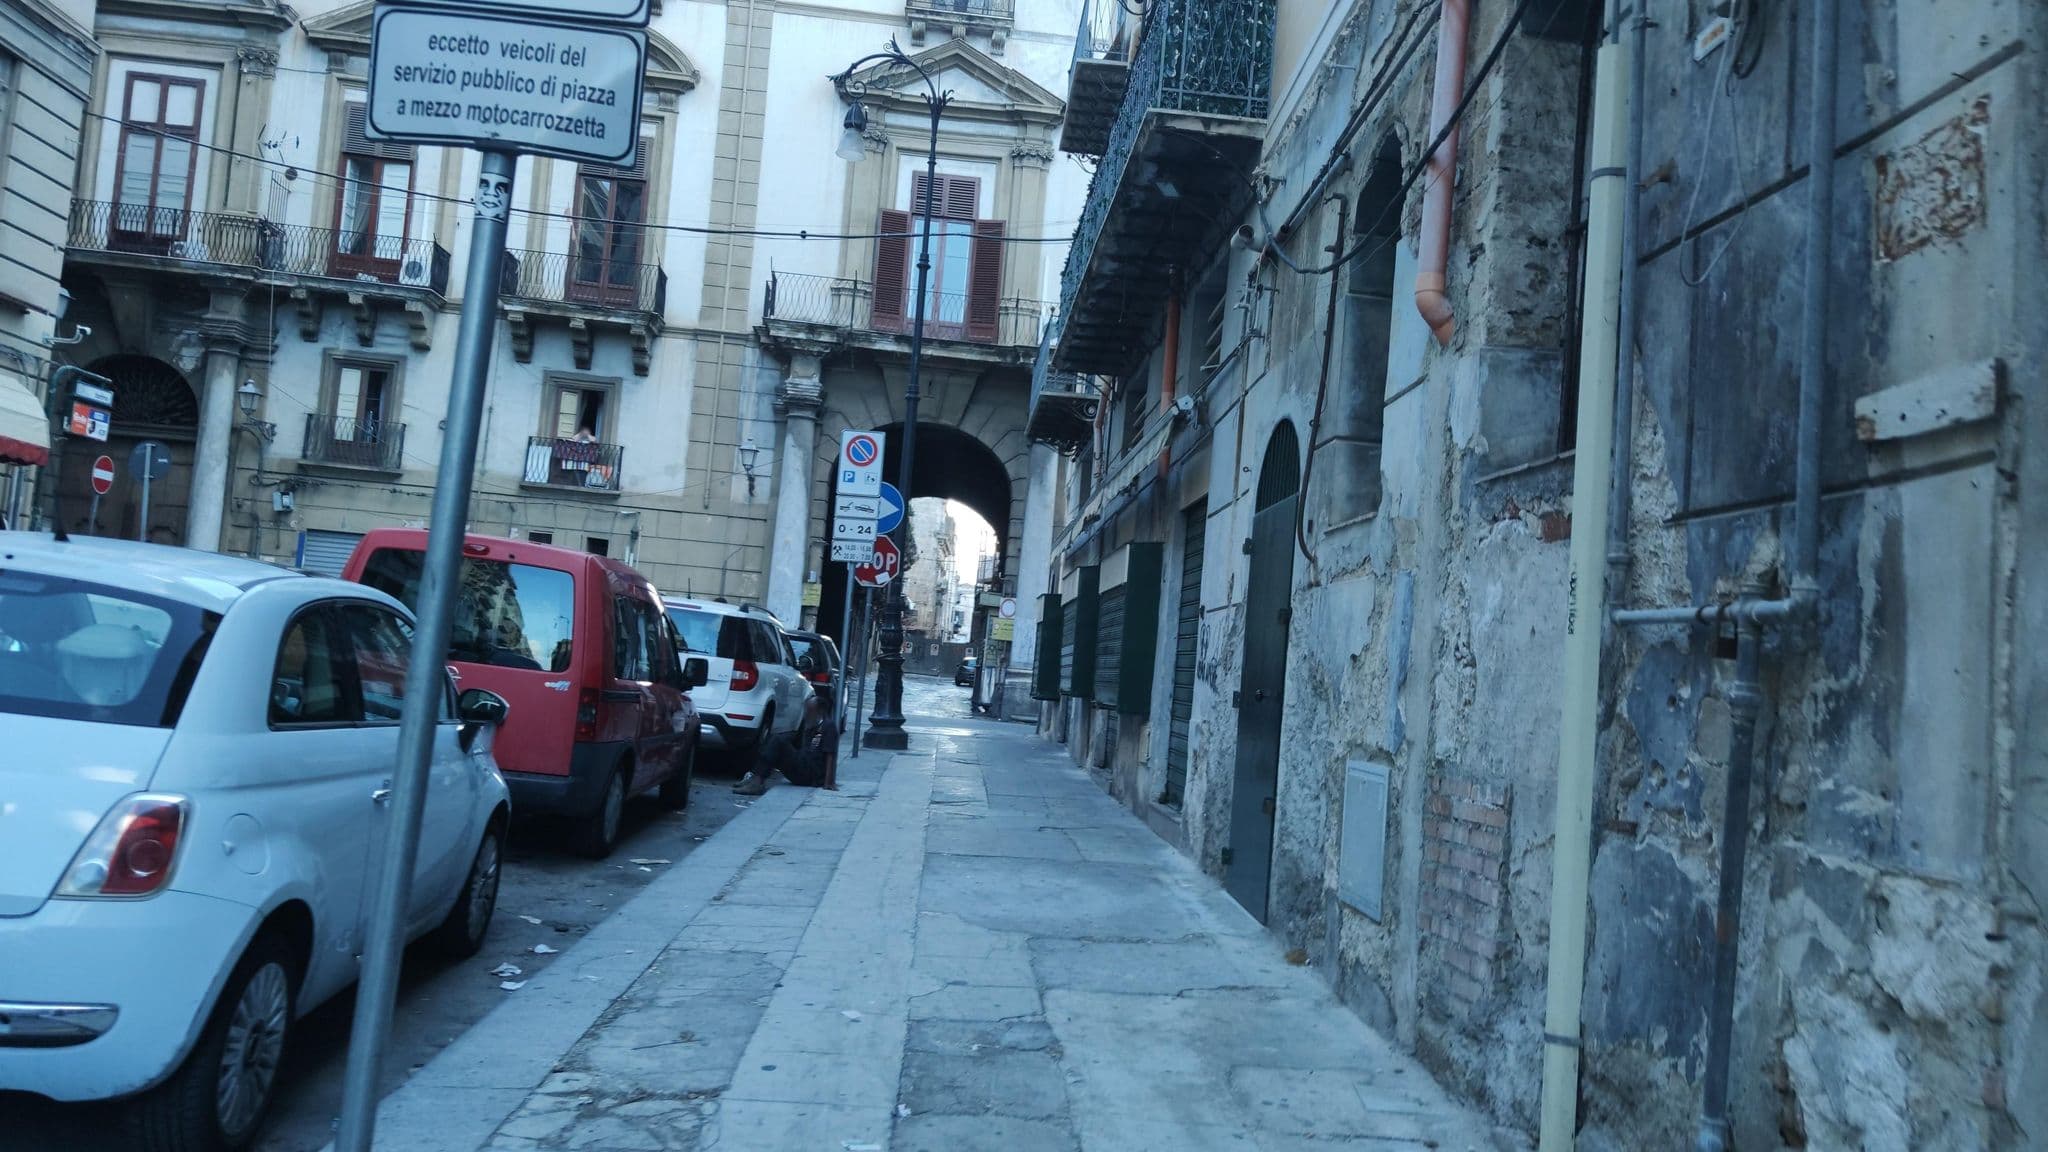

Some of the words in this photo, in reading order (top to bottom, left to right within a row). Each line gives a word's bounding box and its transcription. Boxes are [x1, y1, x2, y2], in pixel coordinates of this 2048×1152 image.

[428, 33, 489, 56] eccetto
[500, 39, 556, 64] veicoli
[560, 46, 587, 68] del
[394, 63, 456, 85] servizio
[461, 68, 535, 94] pubblico
[541, 76, 556, 97] di
[560, 78, 616, 106] piazza
[397, 99, 406, 116] a
[411, 99, 462, 119] mezzo
[466, 104, 605, 140] motocarrozzetta
[857, 525, 872, 534] 24
